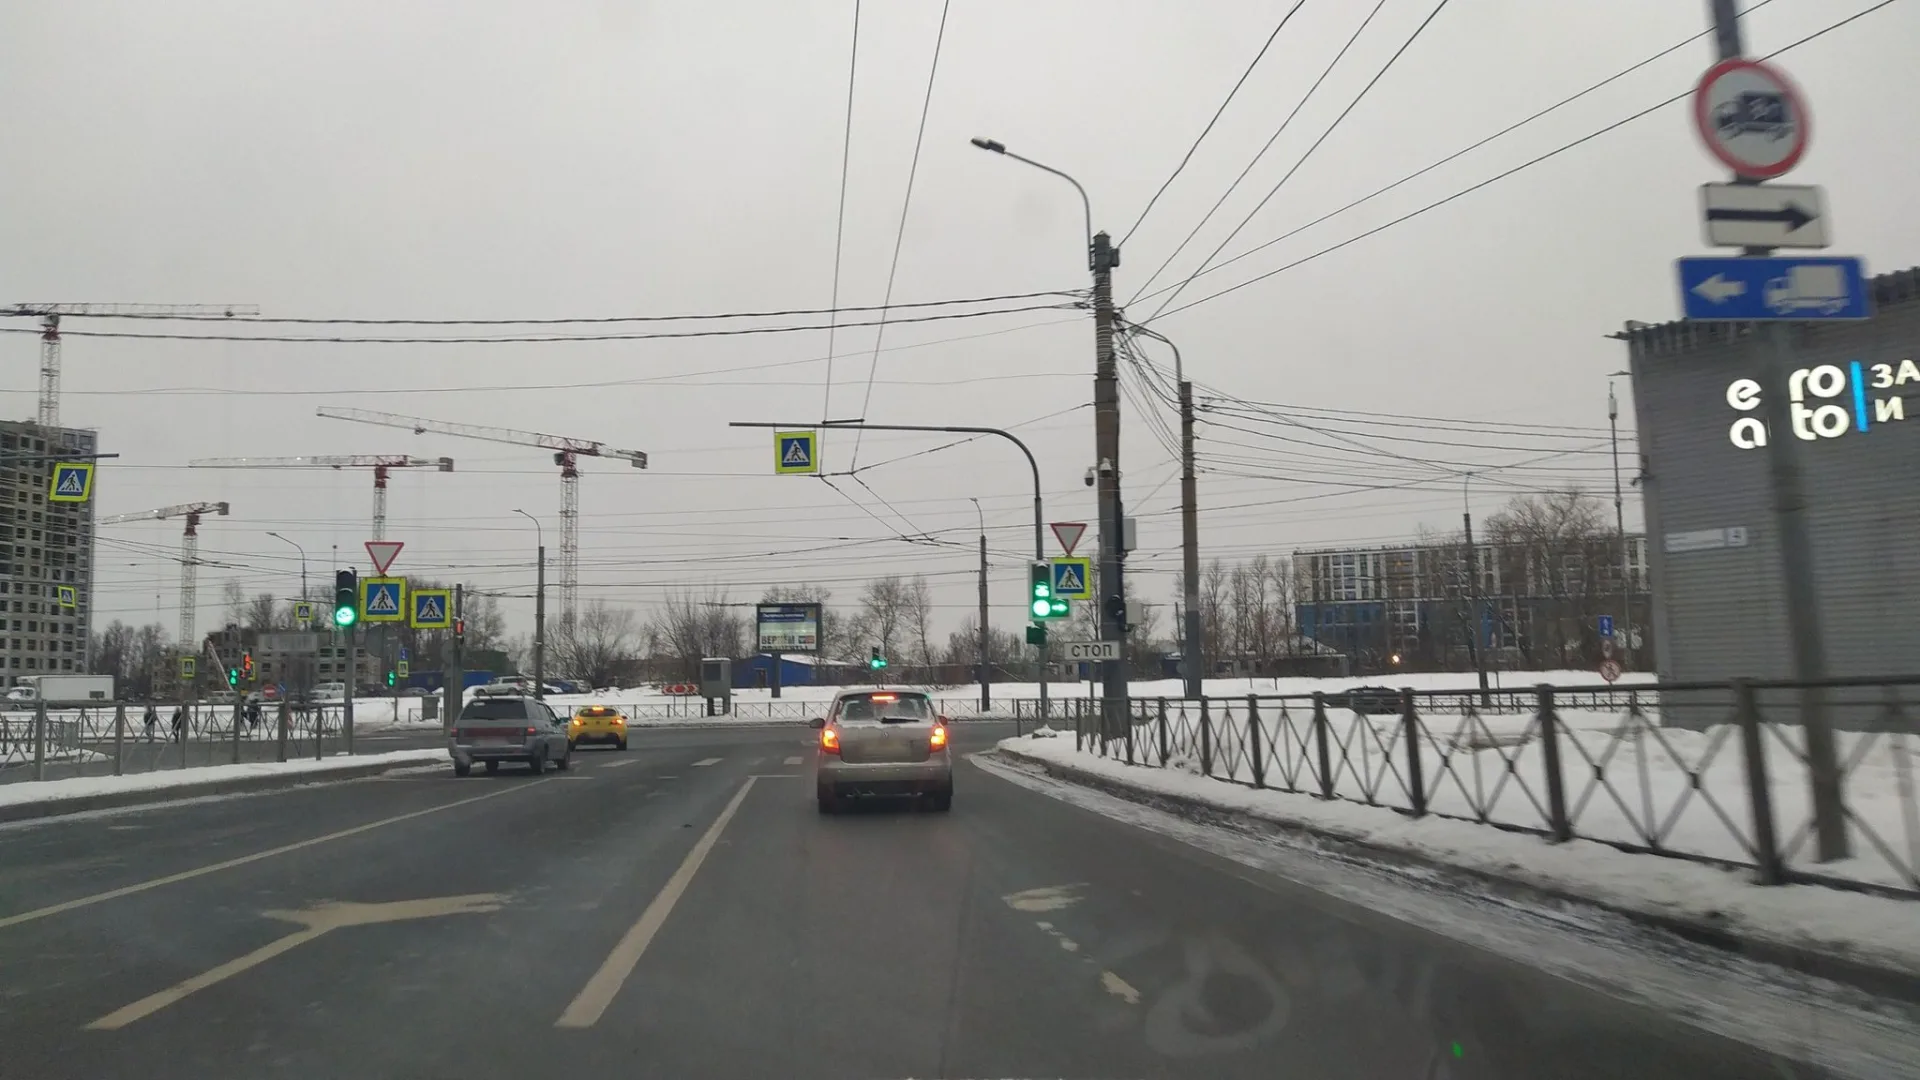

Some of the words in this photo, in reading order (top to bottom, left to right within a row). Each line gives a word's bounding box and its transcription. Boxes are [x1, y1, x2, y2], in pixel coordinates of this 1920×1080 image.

[1726, 364, 1846, 411] ero
[1729, 402, 1850, 450] ato
[1070, 644, 1113, 657] СТОП
